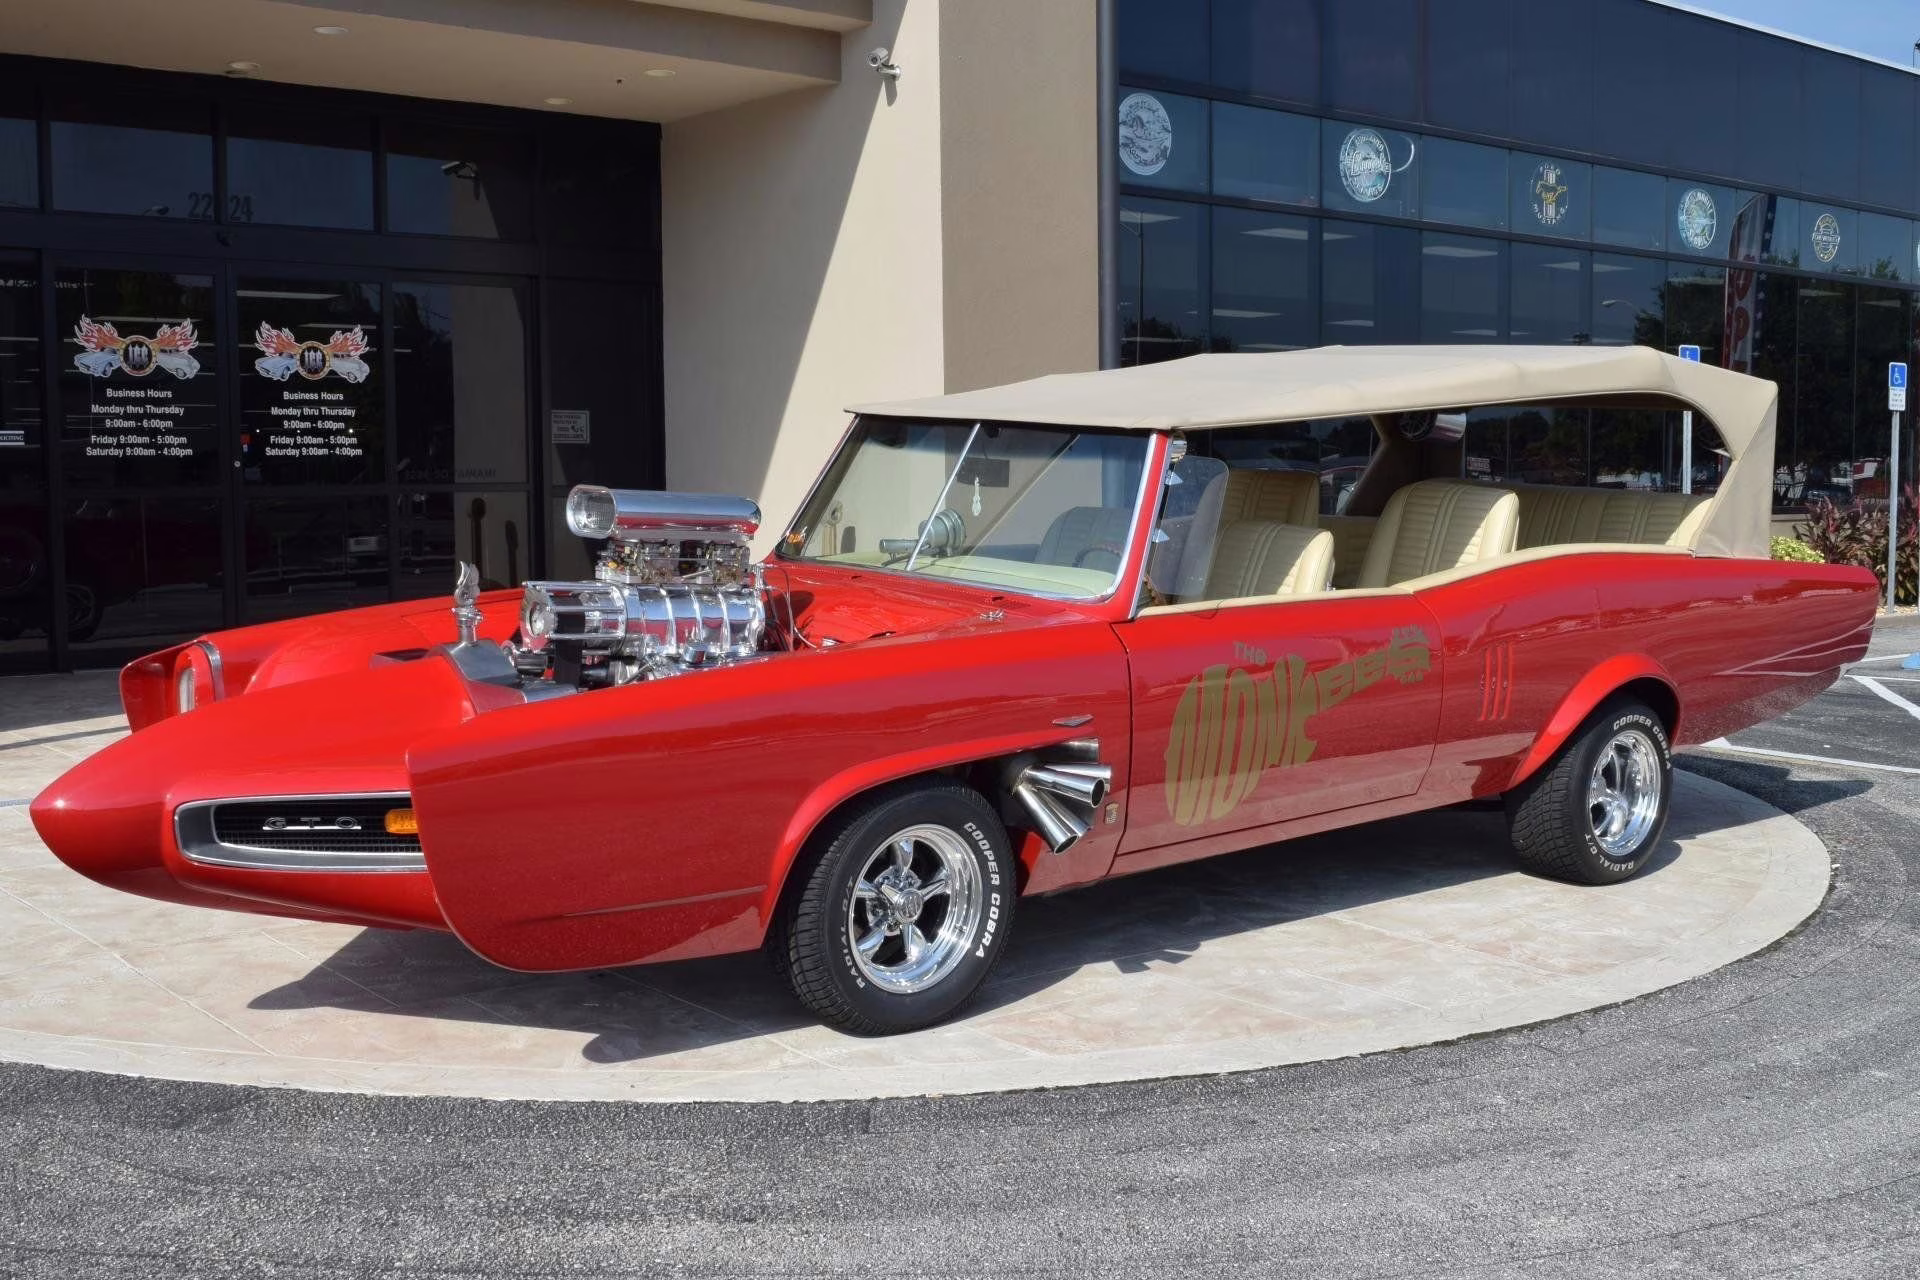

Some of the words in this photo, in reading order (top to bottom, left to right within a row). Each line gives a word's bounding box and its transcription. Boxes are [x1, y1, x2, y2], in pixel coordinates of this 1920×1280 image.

[106, 388, 146, 398] Business
[147, 388, 173, 398] Hours
[283, 391, 319, 400] Business
[320, 392, 344, 400] Hours
[91, 404, 124, 416] Monday
[126, 405, 144, 414] thru
[145, 405, 185, 416] Thursday
[271, 406, 301, 417] Monday
[303, 407, 319, 416] thru
[320, 407, 356, 417] Thursday
[105, 419, 136, 428] 9:00am
[142, 419, 173, 430] 6:00pm
[283, 420, 312, 429] 9:00am
[317, 421, 345, 430] 6:00pm
[91, 435, 118, 446] Friday
[119, 435, 150, 444] 9:00am
[157, 435, 187, 446] 5:00pm
[270, 435, 295, 446] Friday
[296, 435, 324, 445] 9:00am
[329, 435, 358, 446] 5:00pm
[86, 446, 124, 458] Saturday
[125, 447, 156, 456] 9:00am
[162, 447, 193, 458] 4:00pm
[265, 446, 300, 457] Saturday
[301, 447, 329, 456] 9:00am
[334, 447, 363, 457] 4:00pm
[1613, 714, 1653, 731] COOPER
[1652, 725, 1672, 771] COBRA
[264, 816, 359, 830] GTO
[963, 821, 1001, 886] COOPER
[1599, 856, 1635, 873] RADIAL
[975, 893, 1001, 959] COBRA
[840, 923, 867, 989] RADIAL
